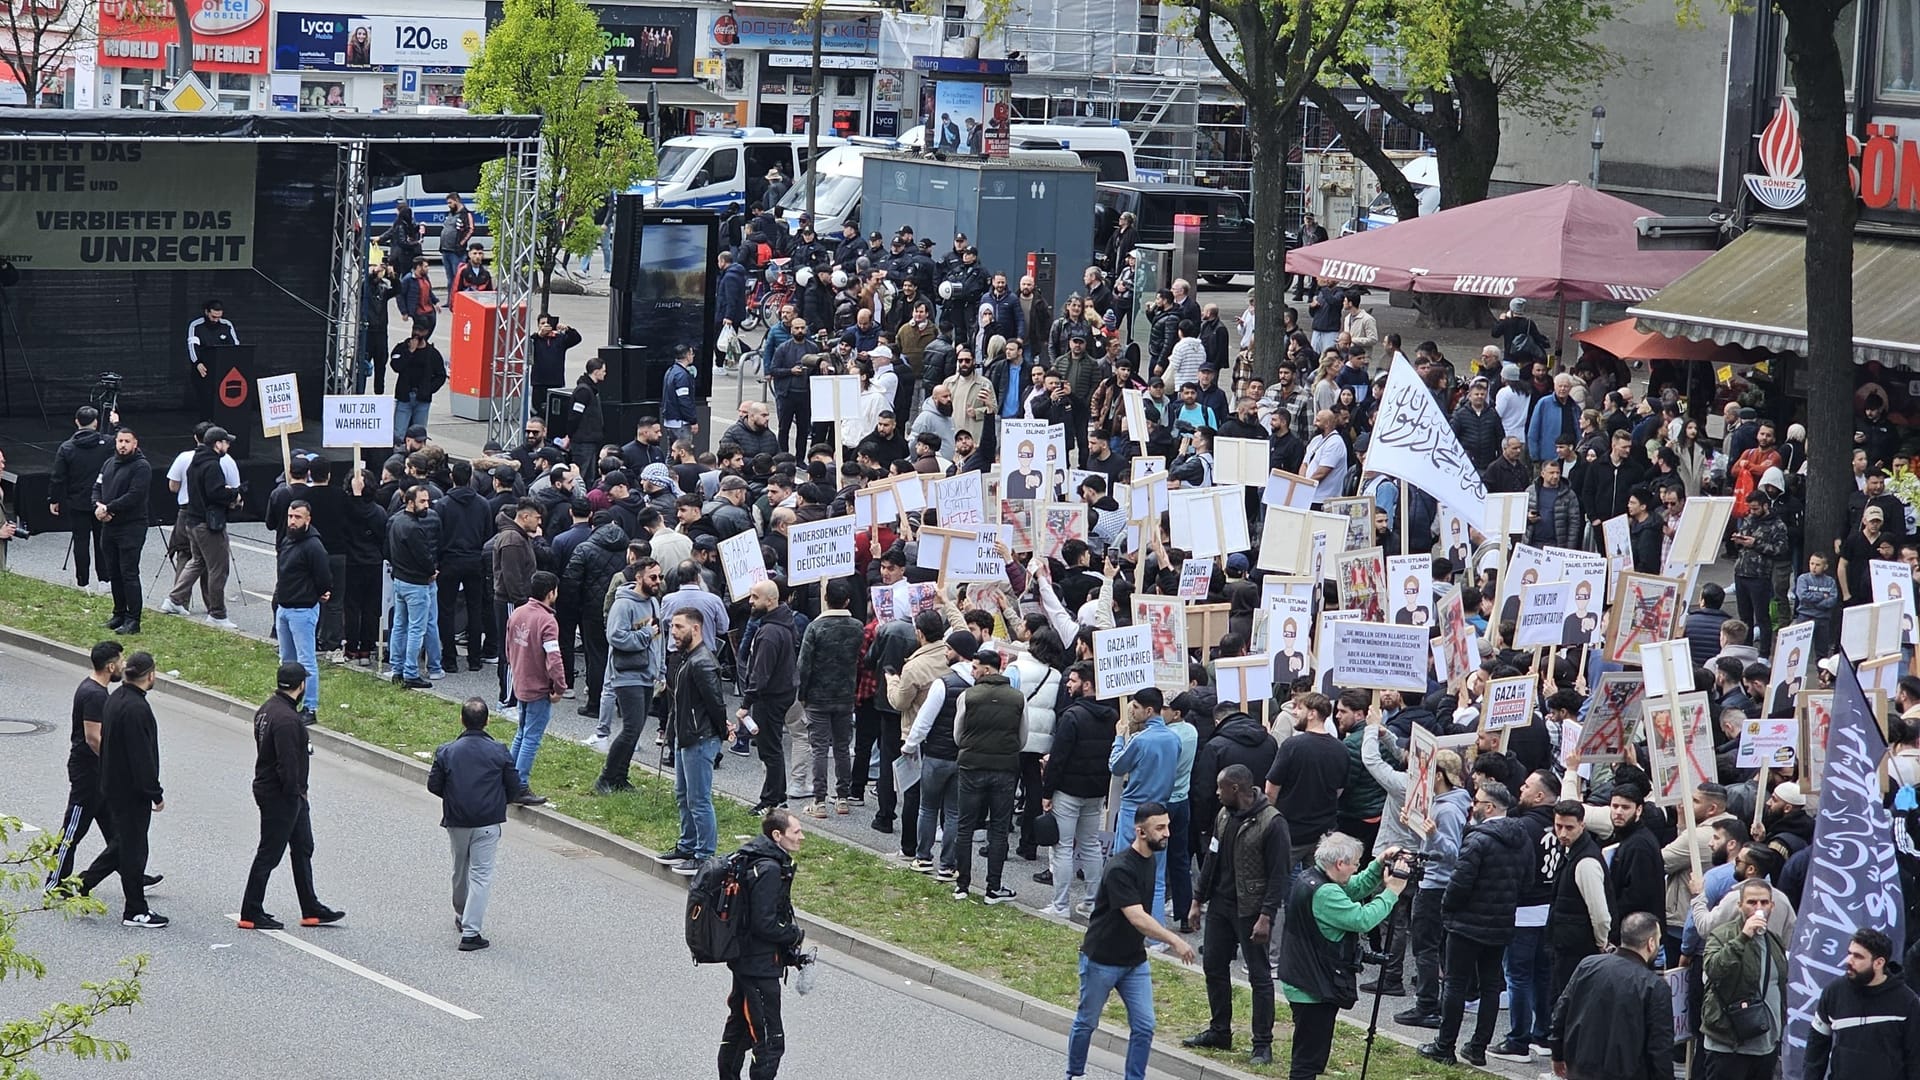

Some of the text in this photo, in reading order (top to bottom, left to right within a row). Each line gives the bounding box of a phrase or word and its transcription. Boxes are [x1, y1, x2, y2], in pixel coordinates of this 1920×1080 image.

[301, 18, 334, 35] Lyca
[841, 26, 880, 38] KIOS
[104, 40, 262, 64] WORLD INTERNET
[405, 73, 413, 88] P
[876, 115, 894, 126] Lyca
[91, 143, 142, 162] DAS
[90, 180, 118, 192] UND
[1762, 178, 1797, 189] SÖNMEZ
[36, 210, 232, 230] VERBIETET DAS
[80, 236, 246, 262] UNRECHT
[1320, 258, 1380, 284] VELTINS
[1453, 274, 1518, 296] VELTINS
[266, 382, 291, 394] STAATS
[340, 403, 376, 414] MUT ZUR
[335, 418, 382, 430] WAHRHEIT
[792, 524, 852, 544] ANDERSDENKEN?
[806, 542, 837, 556] NICHT IN
[796, 552, 851, 572] DEUTSCHLAND
[1184, 562, 1206, 576] Diskurs
[1534, 592, 1558, 606] NEIN ZUR
[1522, 612, 1564, 627] WERTEDIKTATUR
[1107, 635, 1139, 652] GAZA HAT
[1098, 651, 1151, 672] DEN INFO-KRIEG
[1106, 669, 1146, 689] GEWONNEN
[1495, 685, 1516, 701] GAZA
